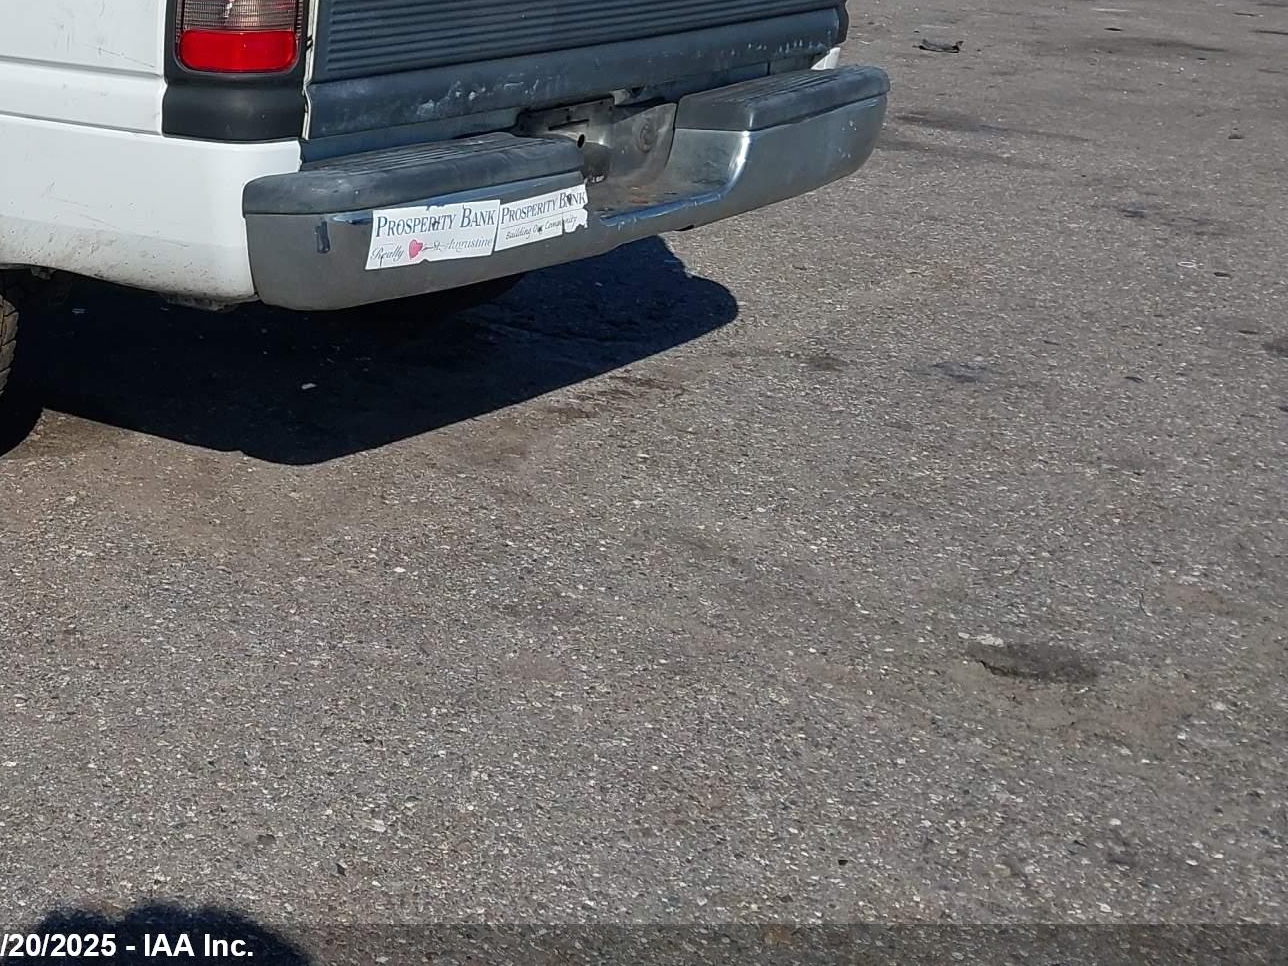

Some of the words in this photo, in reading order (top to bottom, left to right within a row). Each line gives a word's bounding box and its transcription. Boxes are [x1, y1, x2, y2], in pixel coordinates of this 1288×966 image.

[375, 214, 457, 238] PROSPERITY
[460, 207, 497, 228] BANK
[501, 198, 557, 224] PROSPERITY
[505, 224, 532, 240] Building
[532, 224, 544, 234] Or
[544, 214, 578, 231] Commnity
[370, 245, 405, 262] Really
